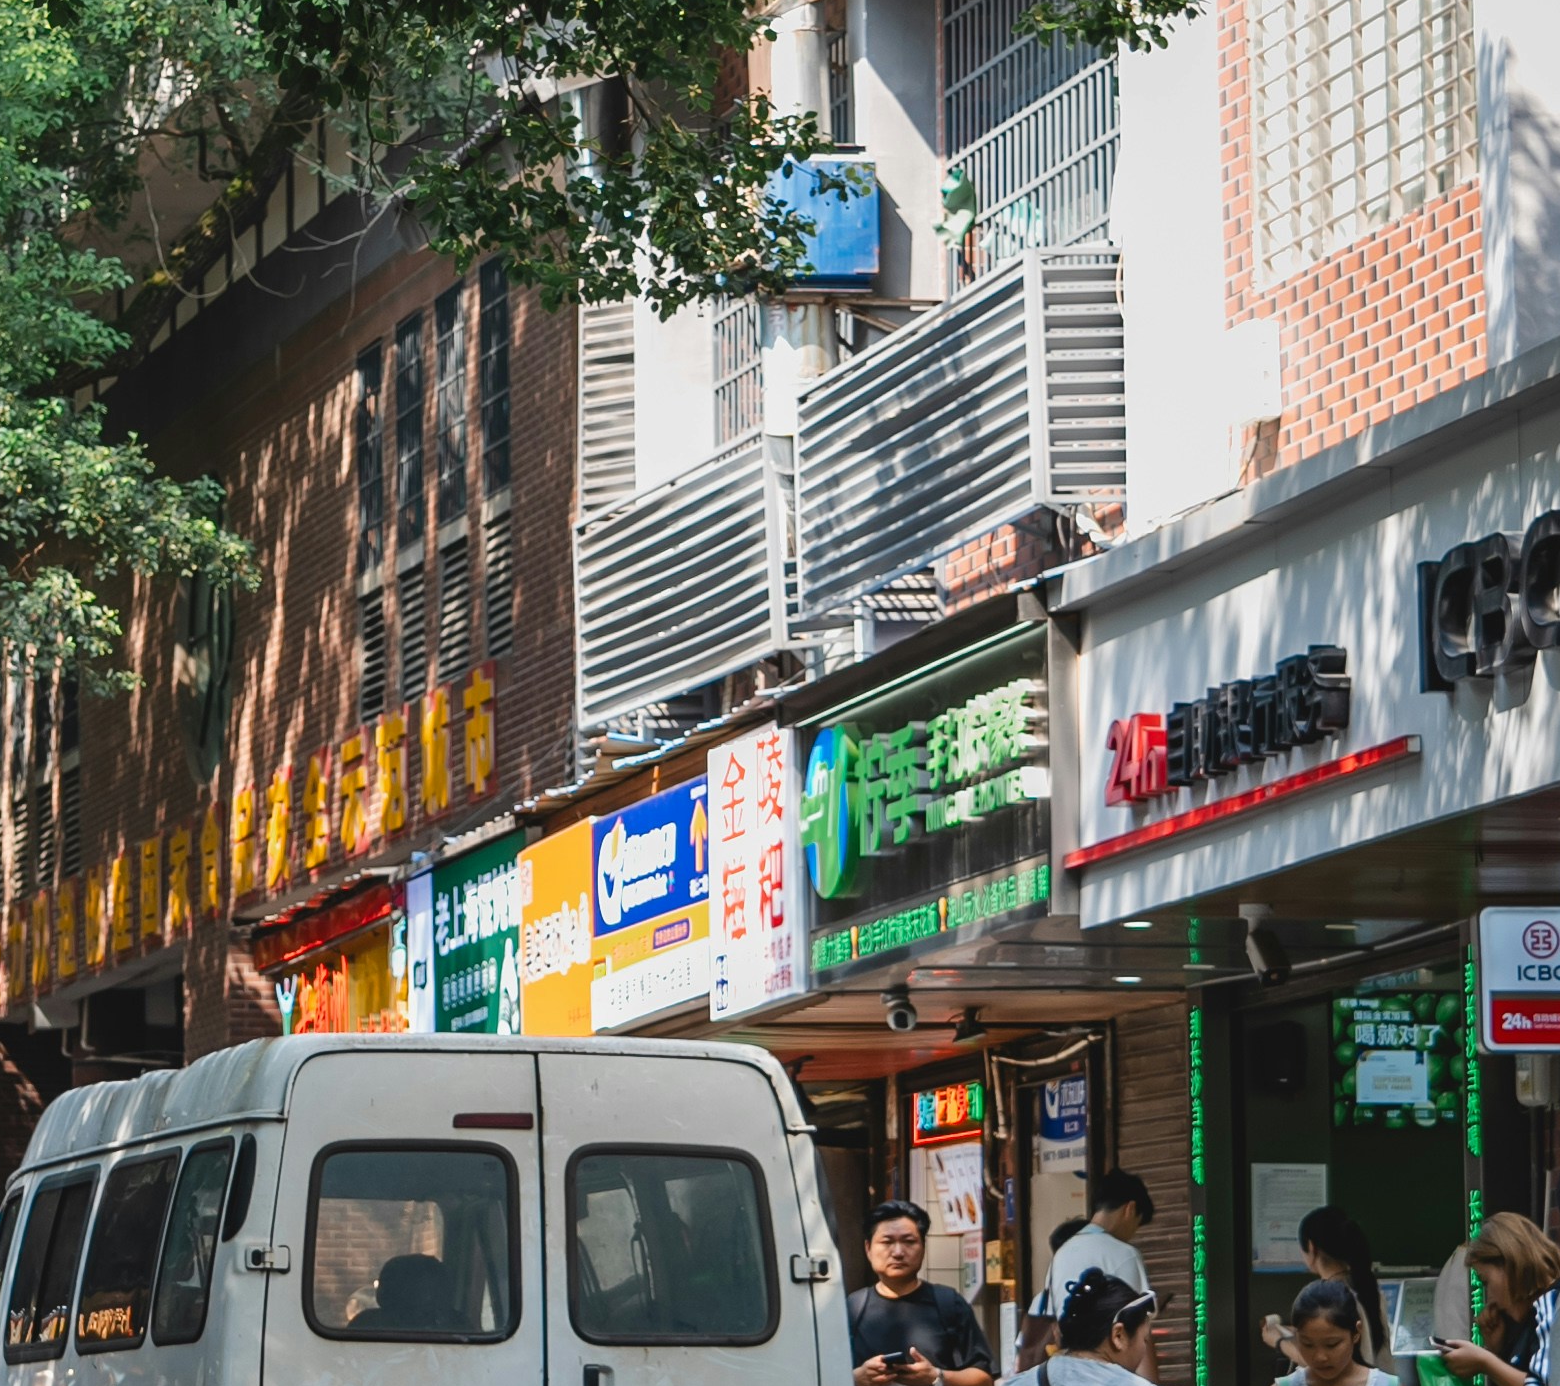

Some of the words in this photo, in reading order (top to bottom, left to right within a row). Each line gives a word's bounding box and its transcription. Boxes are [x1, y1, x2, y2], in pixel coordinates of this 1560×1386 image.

[721, 726, 785, 843] 金陵
[855, 721, 920, 853] 柠季
[1355, 1023, 1441, 1047] 喝就对了
[1502, 1012, 1532, 1030] 24h
